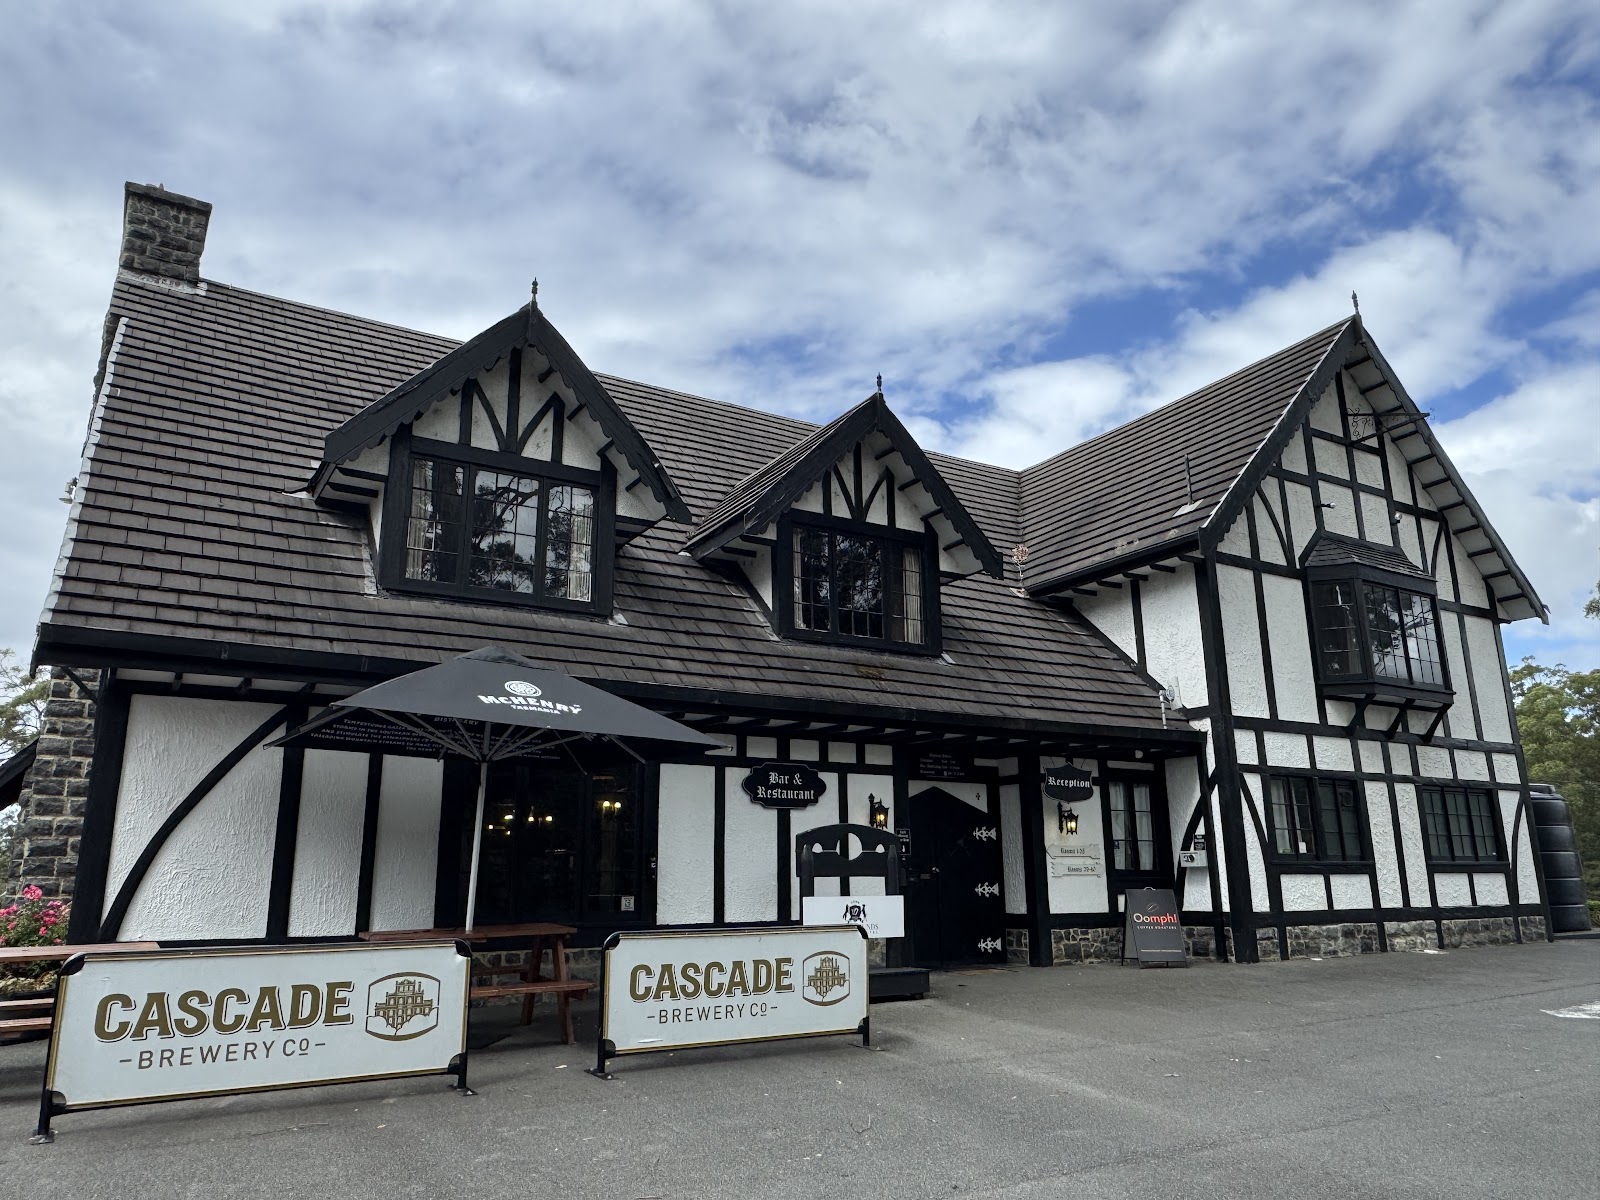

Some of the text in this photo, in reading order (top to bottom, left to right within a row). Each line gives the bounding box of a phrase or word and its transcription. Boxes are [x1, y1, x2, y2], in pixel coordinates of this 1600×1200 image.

[510, 704, 562, 715] TASMANIA
[768, 771, 803, 786] Bar &
[1047, 776, 1090, 789] Reception
[756, 785, 815, 800] Restaurant
[1133, 912, 1178, 926] Oomph!
[629, 957, 795, 1004] CASCADE
[94, 981, 355, 1044] CASCADE
[658, 1003, 746, 1024] BREWERY
[137, 1040, 276, 1070] BREWERY
